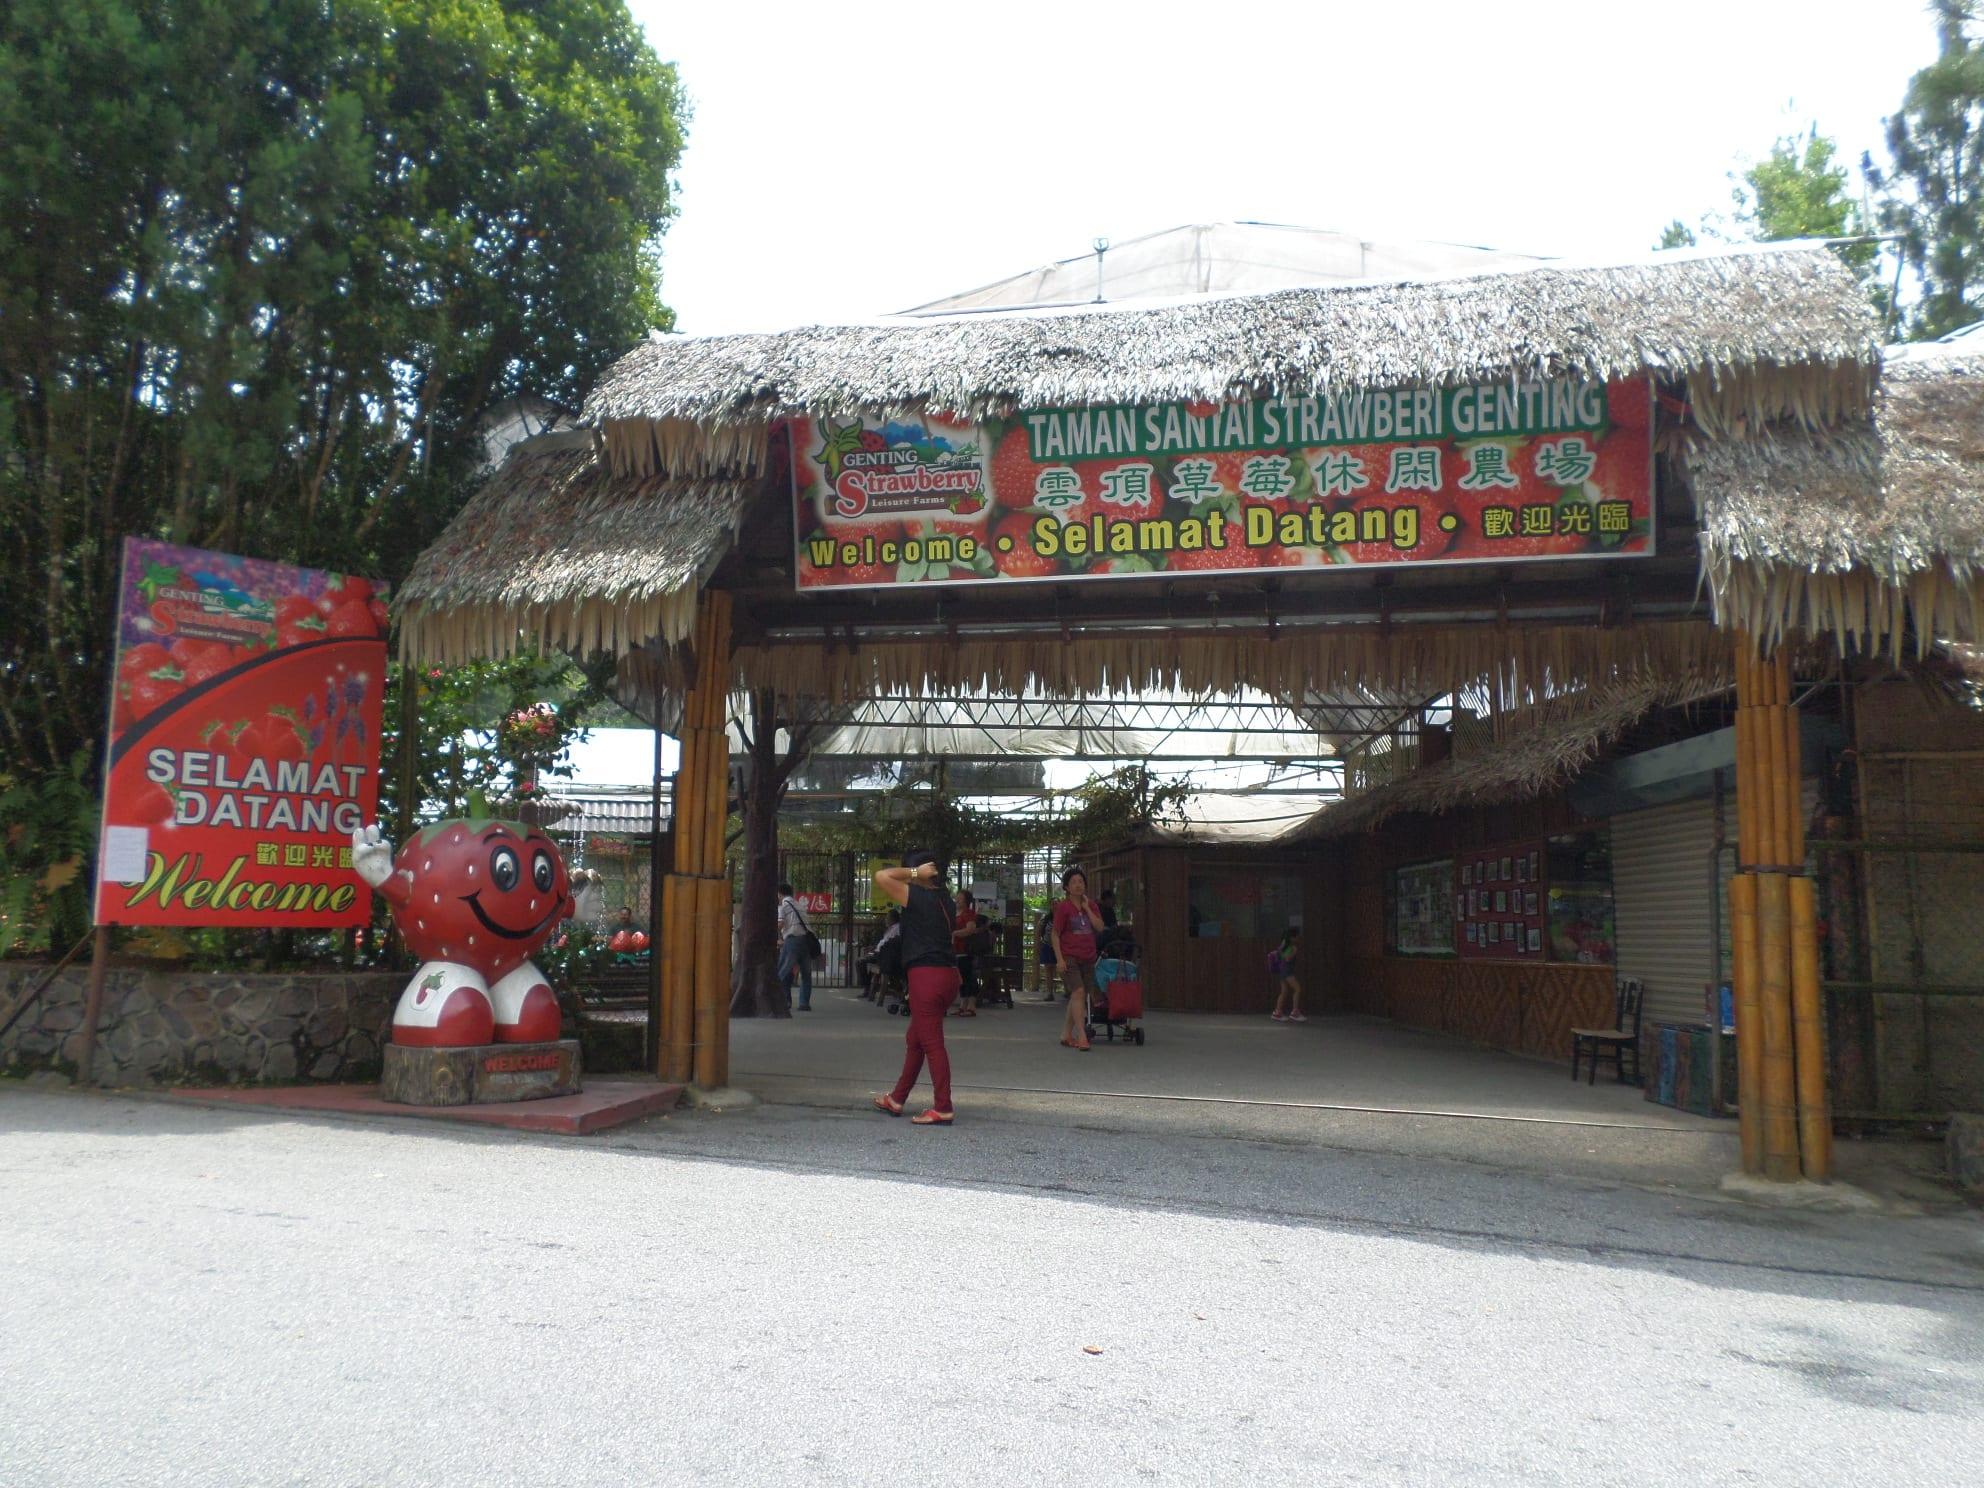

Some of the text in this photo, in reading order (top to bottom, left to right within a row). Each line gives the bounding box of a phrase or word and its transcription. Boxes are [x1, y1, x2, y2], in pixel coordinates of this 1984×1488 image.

[1028, 408, 1136, 457] TAMAN
[1263, 389, 1443, 444] STRAWBERI
[1451, 380, 1601, 433] GENTING
[843, 450, 918, 467] GENTING
[836, 465, 981, 517] Strawberry
[872, 496, 945, 508] Leisure Farms
[810, 506, 1417, 566] Welcome Selamat Datang
[1485, 503, 1630, 536] 歡迎光臨
[160, 587, 224, 606] GENTING
[147, 748, 366, 798] SELAMAT
[176, 790, 361, 835] DATANG
[119, 851, 356, 912] Welcome
[484, 1055, 560, 1073] WELCOME
